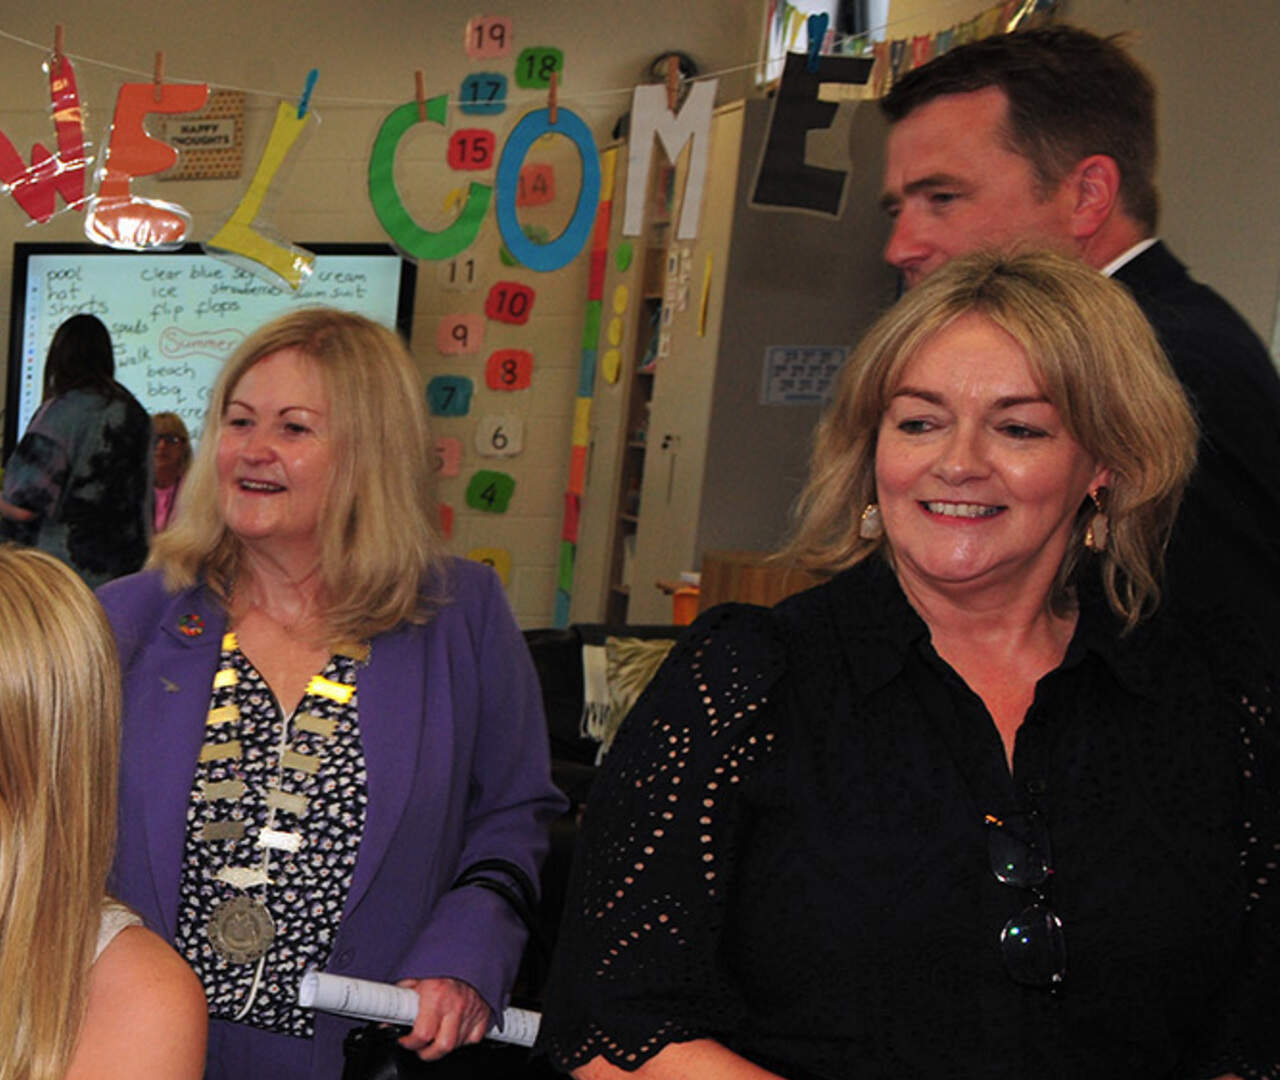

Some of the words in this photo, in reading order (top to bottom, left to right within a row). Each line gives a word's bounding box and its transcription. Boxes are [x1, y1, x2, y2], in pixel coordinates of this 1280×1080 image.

[474, 23, 506, 49] 19
[526, 54, 558, 81] 18
[469, 81, 501, 106] 17
[180, 123, 219, 134] HAPPY
[171, 135, 230, 146] THOUGHTS
[458, 137, 488, 163] 15
[46, 265, 82, 288] pool
[141, 267, 183, 282] clear
[190, 264, 223, 279] blue
[318, 271, 366, 284] cream
[448, 259, 474, 283] 11
[47, 281, 81, 300] hat
[151, 287, 178, 298] ice
[48, 294, 109, 316] shorts
[150, 299, 184, 322] flip
[195, 295, 241, 318] flops
[496, 289, 528, 317] 10
[164, 330, 238, 354] Summer
[451, 324, 469, 347] 9
[118, 346, 153, 368] walk
[147, 363, 196, 379] beach
[501, 358, 518, 385] 8
[147, 381, 187, 403] bbq
[440, 385, 456, 411] 7
[491, 426, 508, 450] 6
[480, 482, 497, 507] 4
